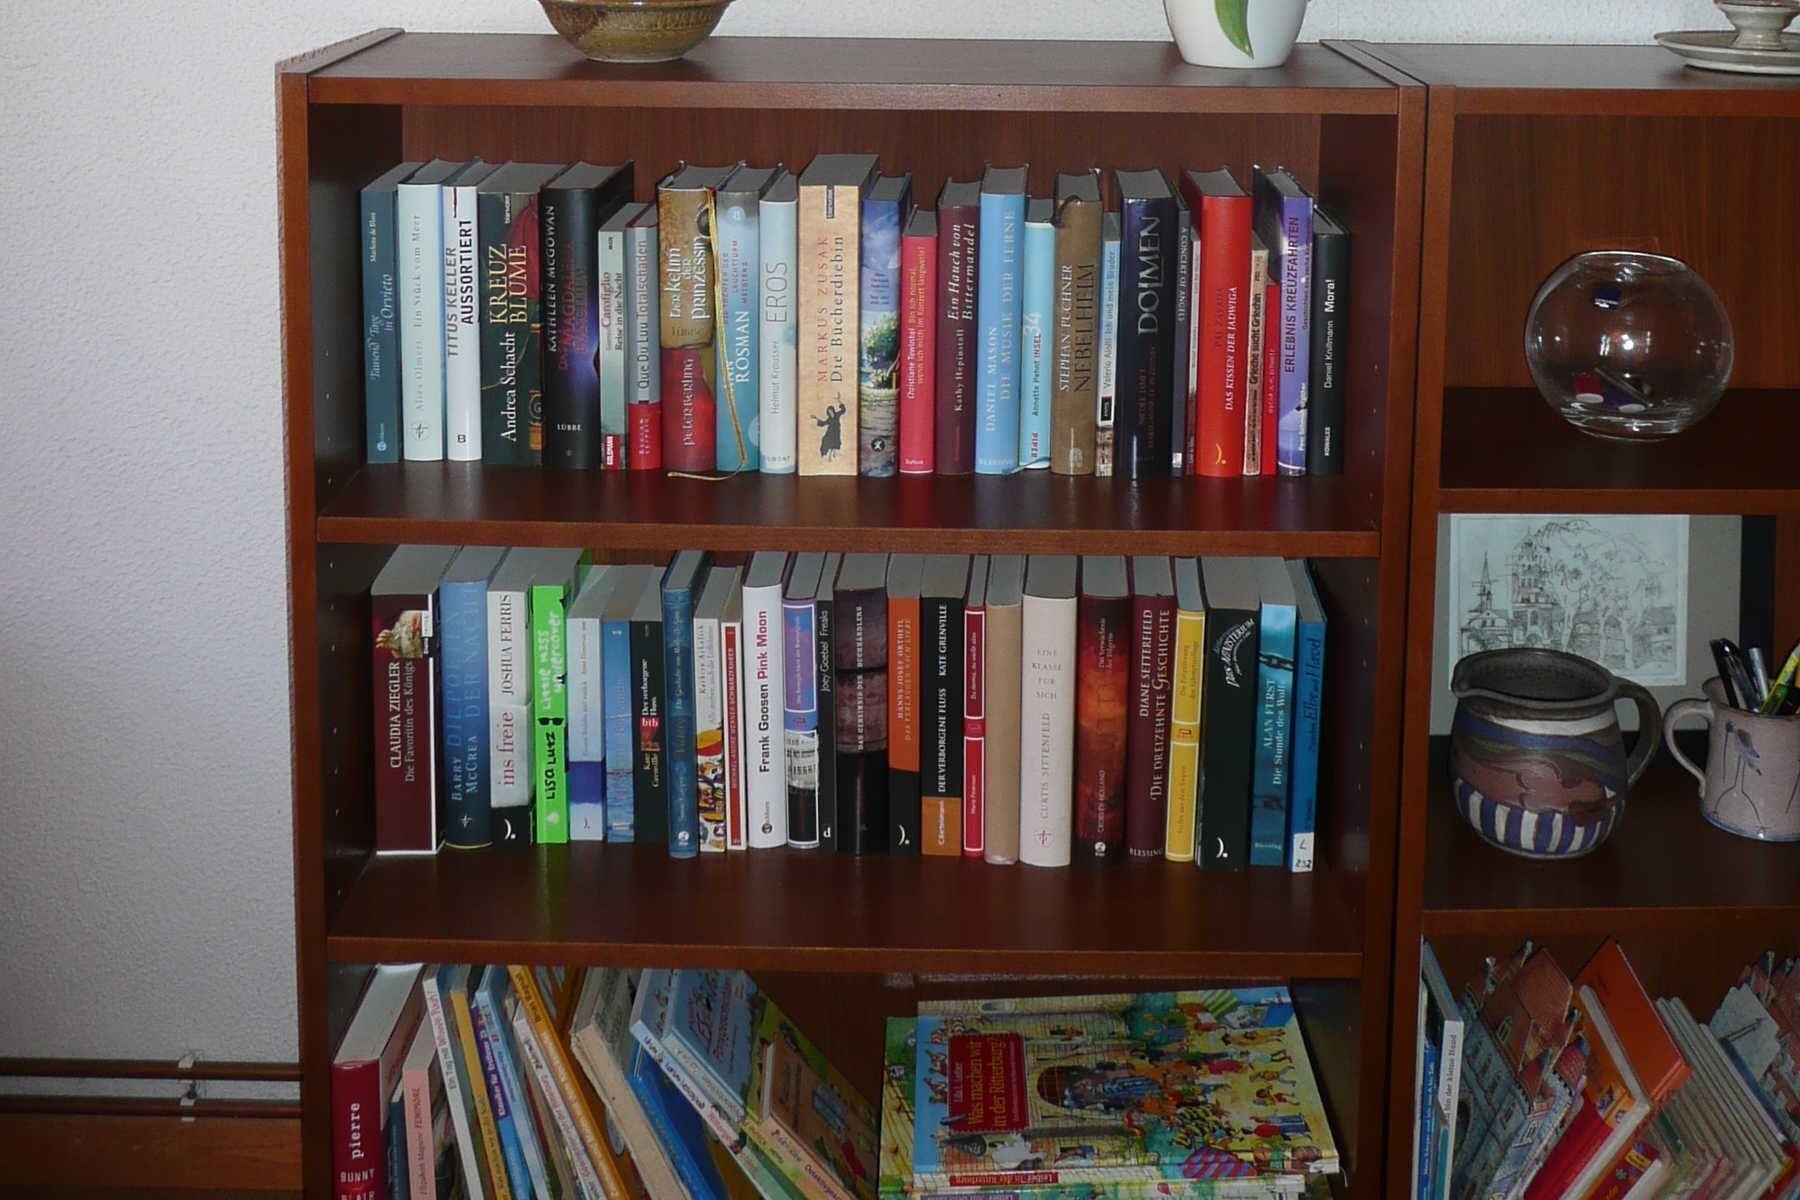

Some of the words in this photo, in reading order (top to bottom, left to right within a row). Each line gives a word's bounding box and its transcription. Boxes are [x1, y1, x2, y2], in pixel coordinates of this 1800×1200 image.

[411, 215, 420, 241] Meer
[950, 224, 961, 247] von
[446, 248, 456, 308] KELLER
[460, 219, 473, 324] AUSSORTIERT
[636, 240, 648, 319] Totalschaden
[817, 235, 828, 295] ZUSAK
[947, 251, 960, 293] Hauch
[962, 224, 975, 320] Bittermandel
[1137, 216, 1164, 334] DOLMEN
[1286, 217, 1299, 311] KREUZFAHRTEN
[380, 274, 393, 320] Orvieto
[410, 276, 421, 306] Stück
[488, 244, 508, 324] KREUZ
[509, 245, 528, 323] BLUME
[614, 272, 622, 298] Nacht
[766, 262, 787, 323] EROS
[829, 236, 844, 347] Bücherdiebin
[1001, 272, 1014, 302] DER
[547, 284, 556, 352] KATHLEEN
[614, 300, 622, 314] die
[614, 316, 622, 324] in
[948, 297, 959, 320] Ein
[1023, 313, 1041, 335] 34
[1227, 287, 1237, 330] JADWIGA
[1252, 293, 1262, 327] Griechin
[447, 314, 458, 357] TITUS
[614, 328, 622, 350] Reise
[637, 322, 648, 342] Luu
[817, 307, 828, 382] MARKUS
[1001, 312, 1012, 362] MUSIK
[1074, 264, 1095, 392] NEBELHEIM
[1227, 333, 1236, 352] DER
[1251, 330, 1260, 351] sucht
[1285, 315, 1296, 373] ERLEBNIS
[500, 332, 516, 385] Schacht
[638, 346, 648, 362] Du
[734, 311, 750, 382] ROSMAN
[987, 327, 997, 375] MASON
[1060, 335, 1071, 392] STEPHAN
[638, 366, 649, 389] Que
[830, 351, 844, 382] Die
[1226, 355, 1235, 388] KISSEN
[1249, 355, 1260, 384] Grieche
[1324, 363, 1333, 388] Daniel
[770, 382, 780, 414] Helmut
[954, 383, 964, 411] Kathy
[1000, 374, 1010, 400] DIE
[1032, 384, 1040, 416] Annette
[1226, 392, 1234, 410] DAS
[501, 390, 517, 442] Andrea
[986, 384, 996, 432] DANIEL
[500, 595, 512, 642] FERRIS
[756, 610, 768, 647] Moon
[938, 605, 947, 652] GRENVILLE
[820, 642, 830, 671] Goebel
[1140, 610, 1152, 680] SETTERFIELD
[1152, 609, 1170, 690] GESCHICHTE
[404, 662, 416, 695] Königs
[502, 648, 514, 696] JOSHUA
[757, 652, 768, 679] Pink
[820, 672, 831, 691] Joey
[938, 656, 947, 676] KATE
[389, 662, 400, 711] ZIEGLER
[938, 688, 946, 712] FLUSS
[1140, 684, 1150, 717] DIANE
[1265, 679, 1275, 715] FURST
[405, 698, 414, 714] des
[758, 684, 770, 731] Goosen
[1275, 710, 1284, 727] des
[390, 714, 401, 768] CLAUDIA
[404, 718, 415, 762] Favoritin
[496, 712, 514, 752] freie
[938, 716, 946, 774] VERBORGENE
[1041, 712, 1050, 776] SITTENFELD
[1153, 694, 1166, 770] DREIZEHNTE
[1264, 719, 1273, 748] ALAN
[1274, 730, 1284, 764] Stunde
[758, 736, 770, 772] Frank
[405, 765, 415, 781] Die
[498, 760, 514, 785] ins
[938, 776, 946, 792] DER
[1272, 768, 1282, 784] Die
[1040, 782, 1049, 820] CURTIS
[348, 1102, 364, 1159] pierre
